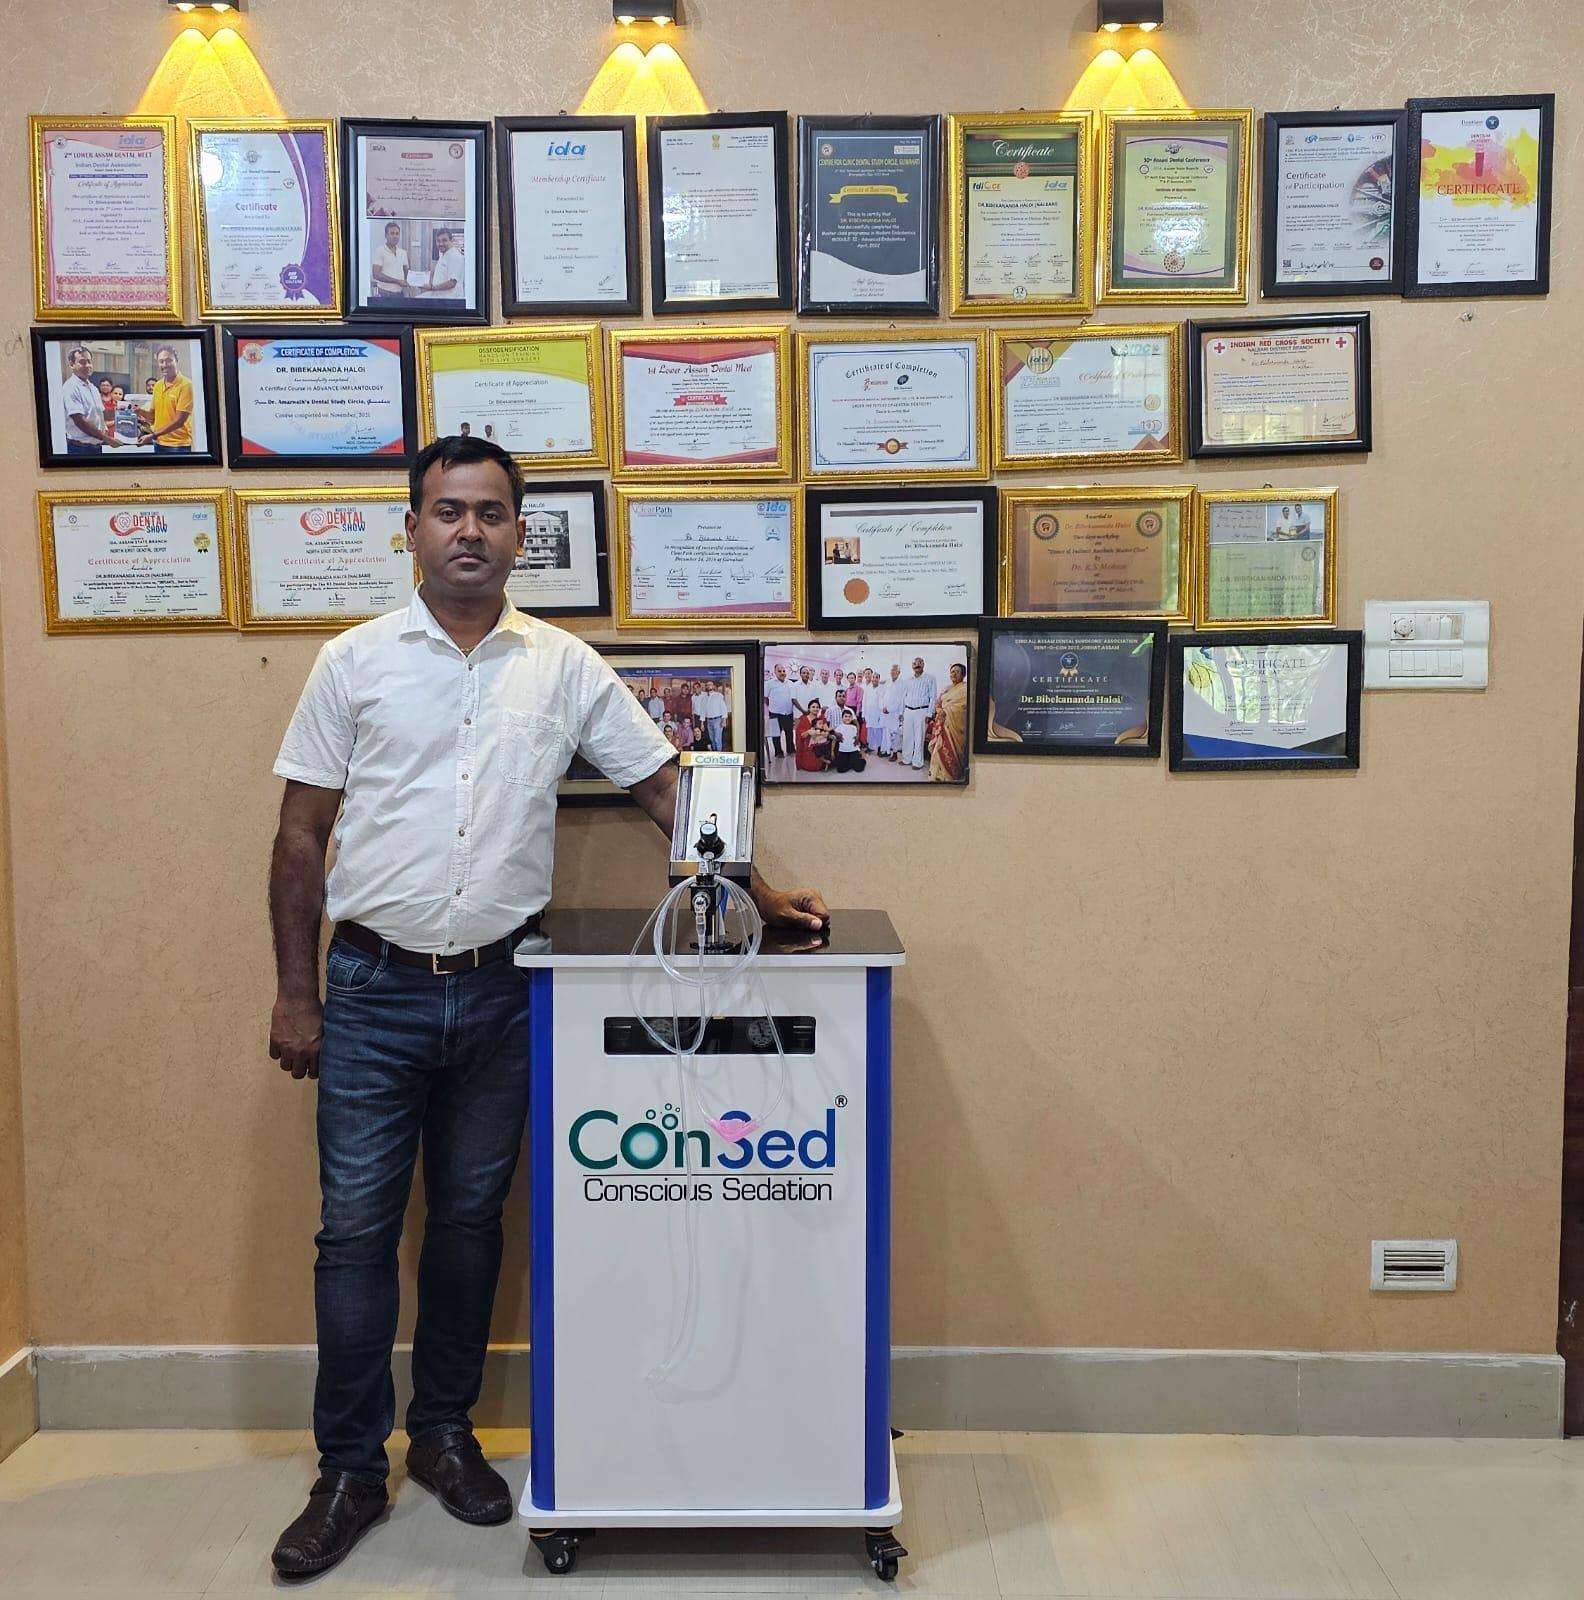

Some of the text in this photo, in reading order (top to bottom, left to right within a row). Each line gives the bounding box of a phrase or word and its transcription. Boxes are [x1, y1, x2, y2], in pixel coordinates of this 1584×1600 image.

[548, 141, 585, 156] ida
[992, 140, 1054, 161] Certificate
[532, 175, 605, 184] Membership Certificate
[1294, 182, 1344, 192] Participation
[1437, 183, 1520, 195] CERTIFICATE
[236, 203, 277, 211] Certificate
[281, 348, 315, 356] CERTIFICATE
[325, 348, 359, 356] COMPLETION
[659, 365, 680, 374] Lower
[684, 365, 707, 374] Assam
[711, 364, 732, 372] Dental
[736, 364, 752, 372] Meet
[845, 363, 883, 379] Certificate
[895, 361, 938, 378] Completion
[766, 502, 786, 512] ida
[133, 515, 165, 527] DENTAL
[327, 511, 362, 524] DENTAL
[147, 524, 167, 533] SHOW
[342, 522, 365, 531] SHOW
[856, 523, 893, 536] Certificate
[910, 521, 952, 535] Completion
[1021, 695, 1034, 703] Dr.
[1036, 695, 1095, 704] Bibekananda
[695, 755, 740, 764] ConSed
[569, 1108, 836, 1169] ConSed
[584, 1176, 832, 1202] Conscious Sedation
